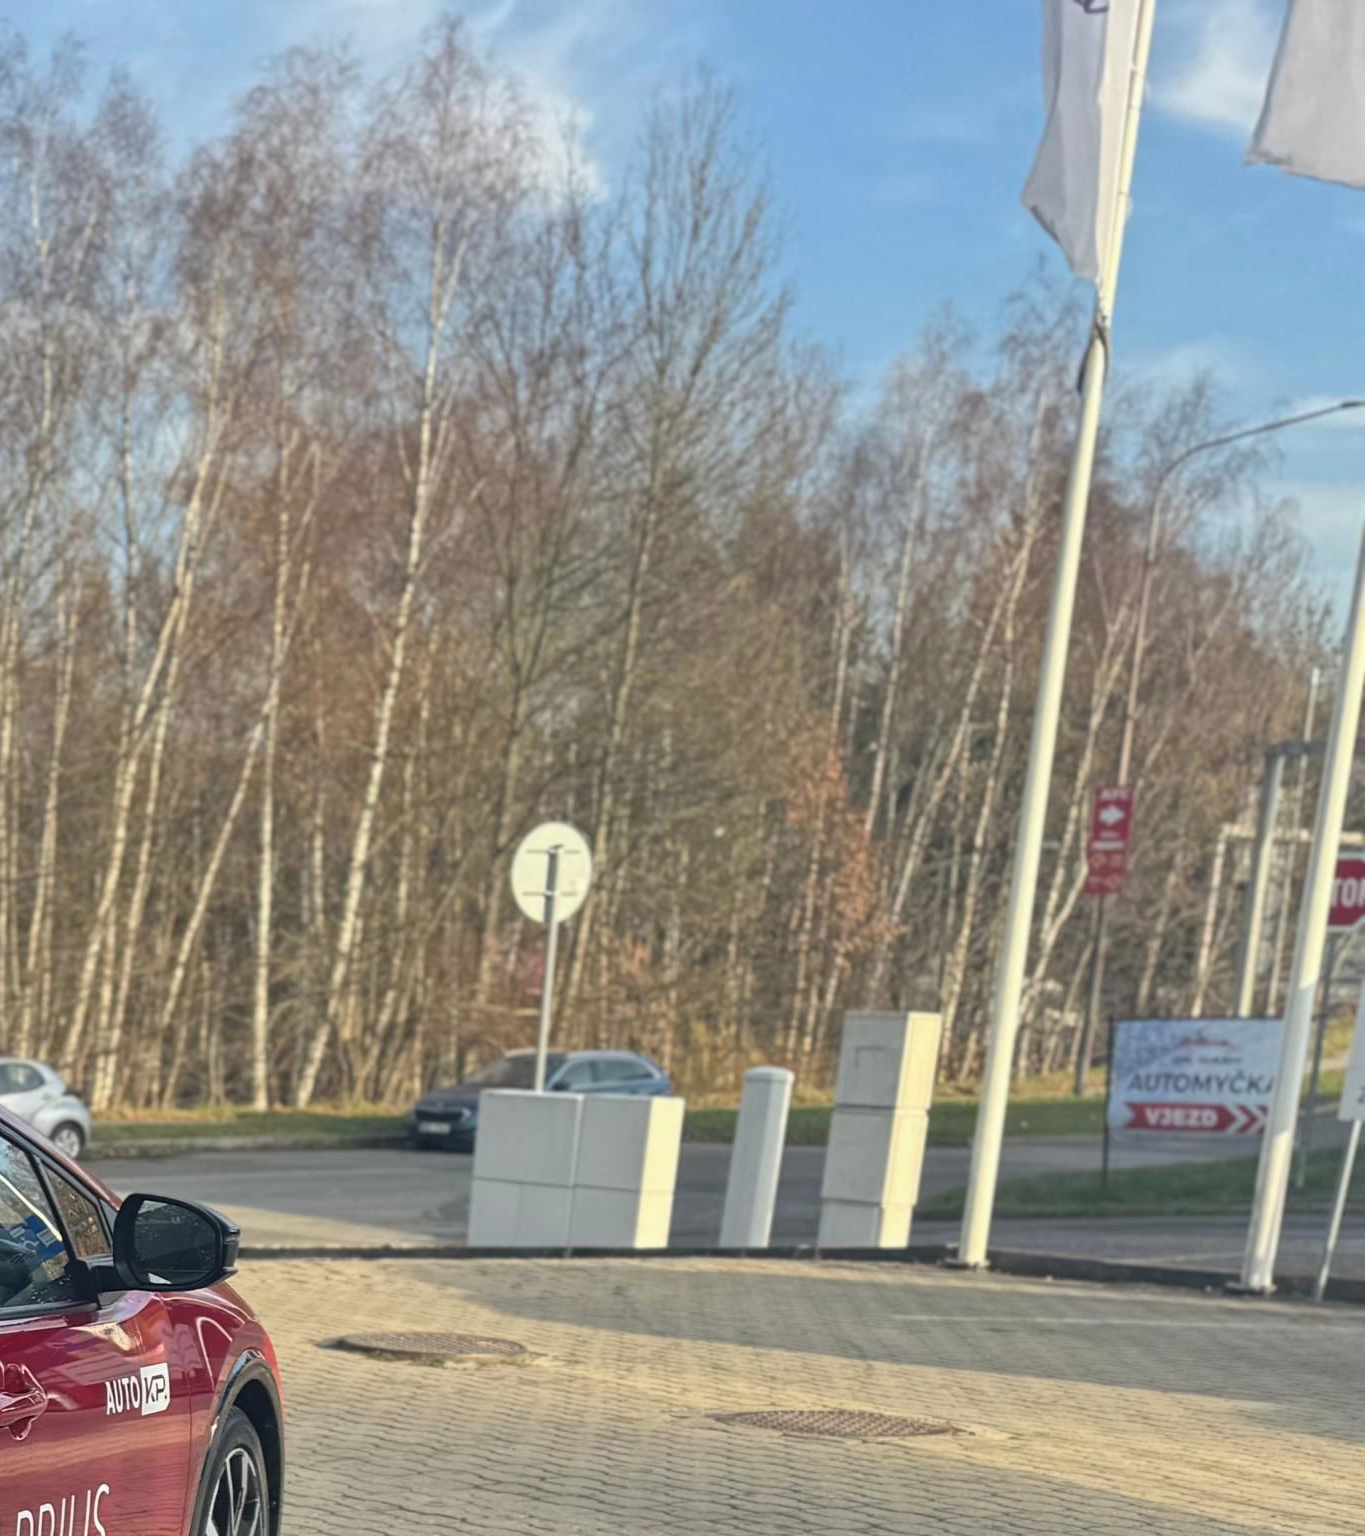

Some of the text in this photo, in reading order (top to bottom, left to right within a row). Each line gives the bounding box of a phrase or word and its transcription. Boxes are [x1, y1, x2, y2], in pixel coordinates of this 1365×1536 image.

[1333, 876, 1365, 908] TO
[1143, 1106, 1219, 1127] VJEZD
[105, 1376, 140, 1415] AUTO
